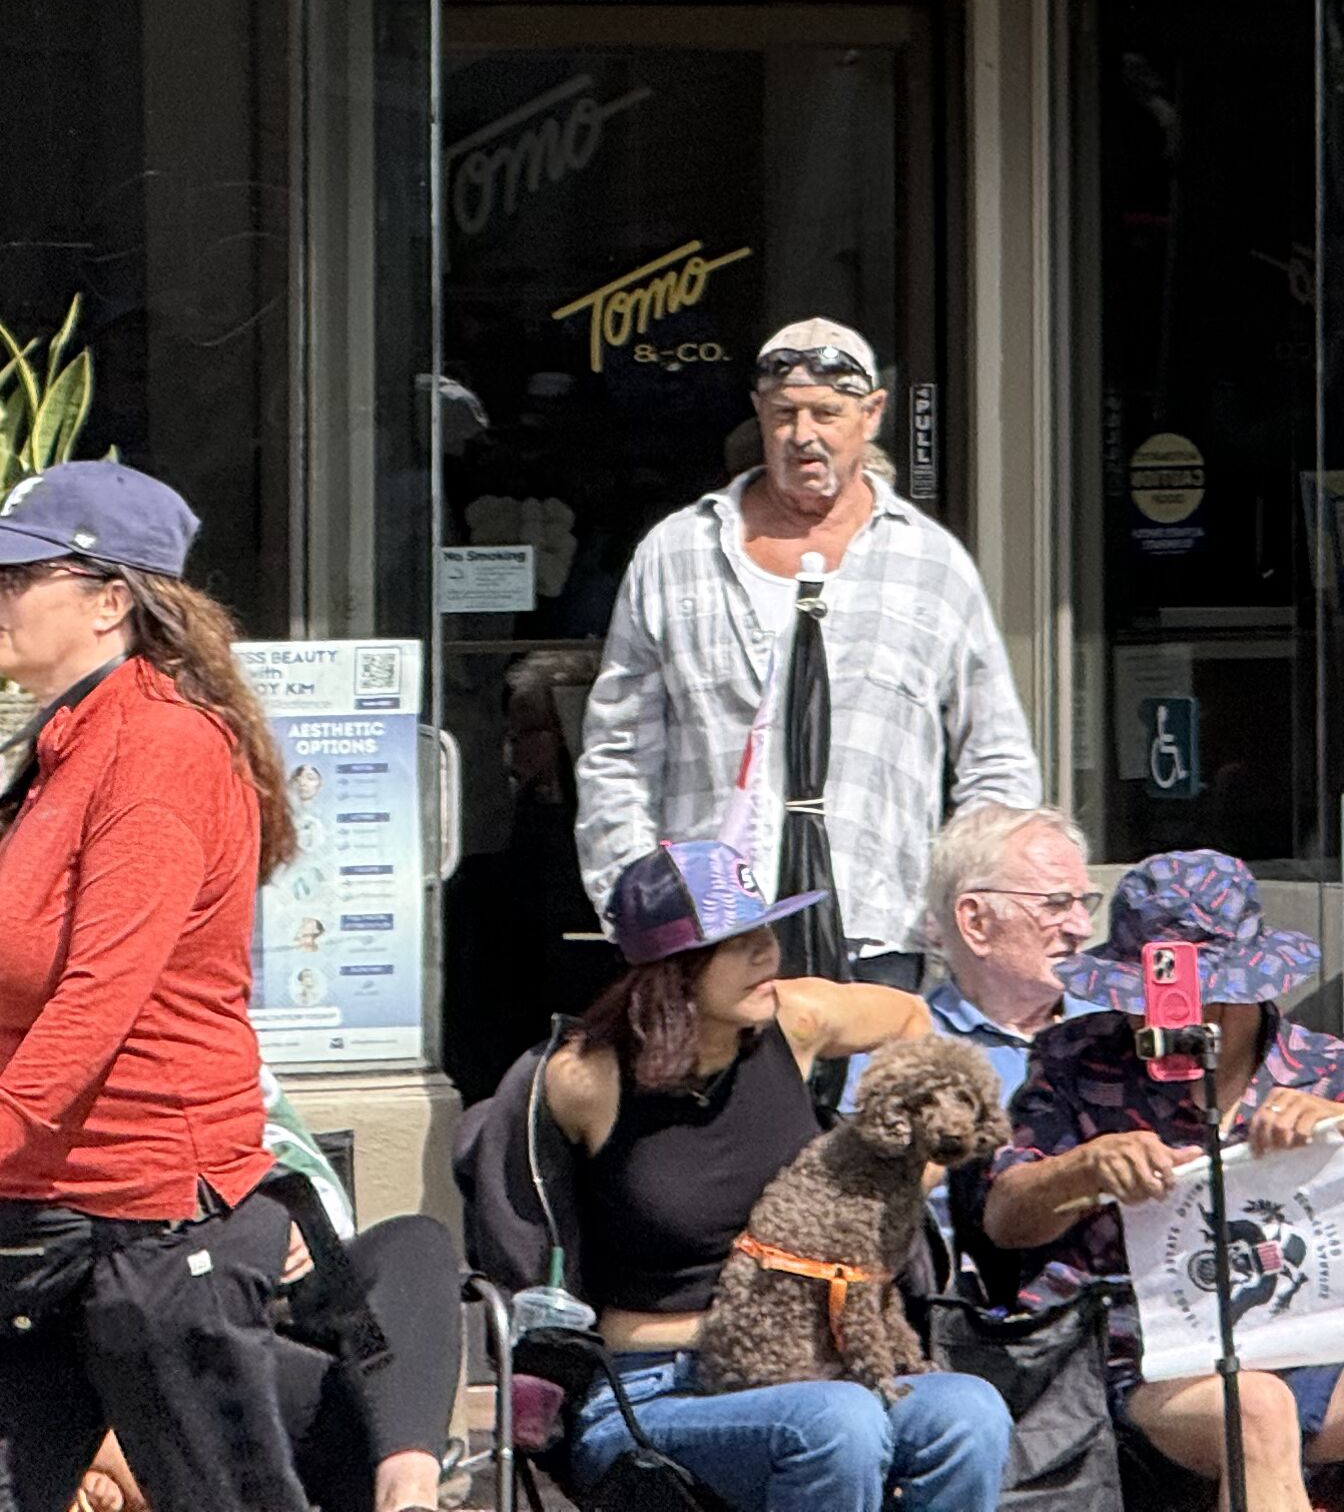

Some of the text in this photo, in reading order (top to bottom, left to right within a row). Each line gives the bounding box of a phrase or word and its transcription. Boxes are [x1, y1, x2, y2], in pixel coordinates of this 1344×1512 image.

[552, 240, 753, 373] Tomo
[915, 399, 931, 463] PULL
[271, 650, 338, 664] BEAUTY
[288, 721, 387, 738] AESTHETIC
[295, 739, 379, 756] OPTIONS
